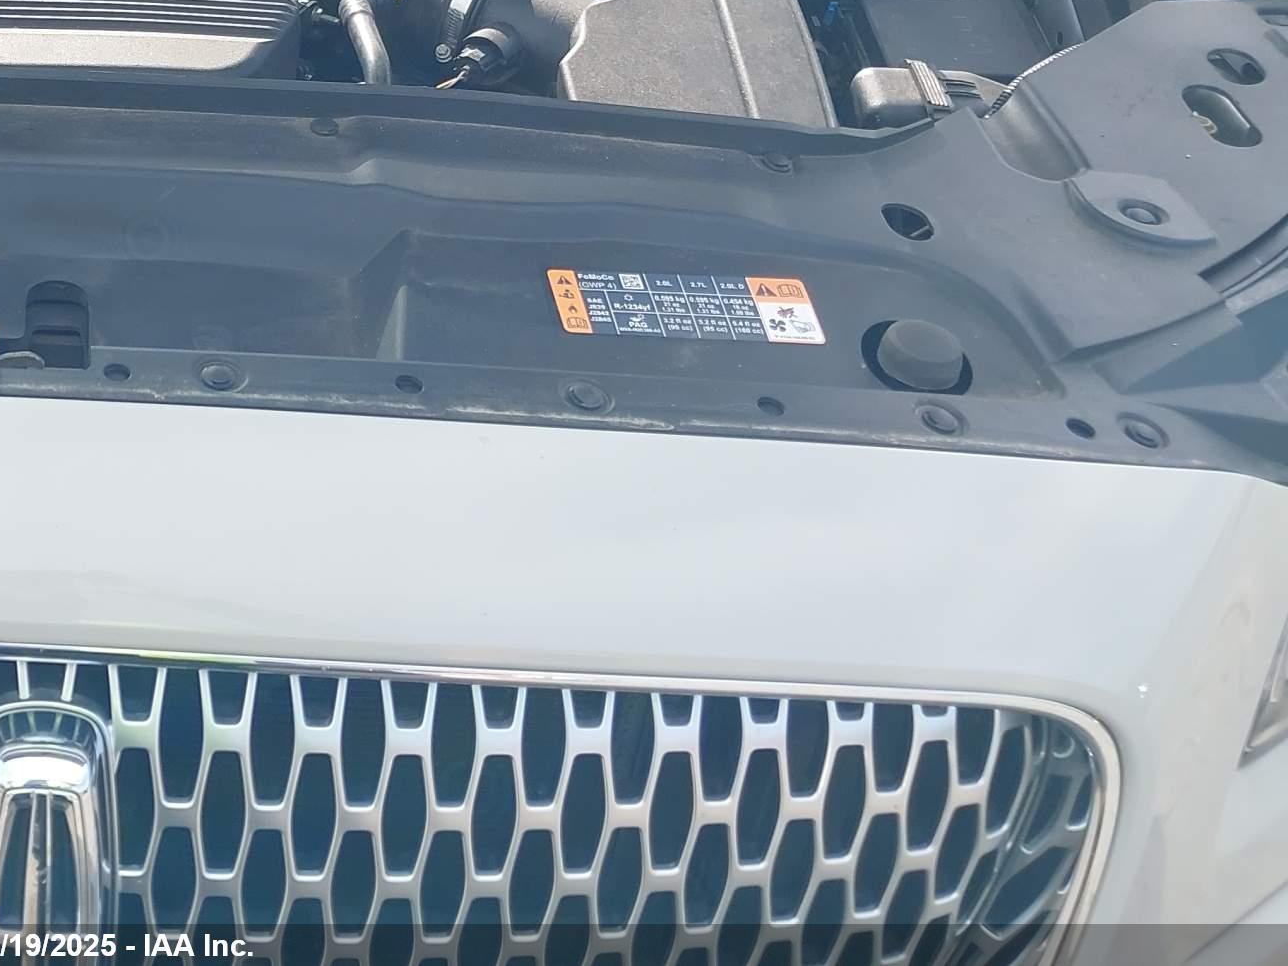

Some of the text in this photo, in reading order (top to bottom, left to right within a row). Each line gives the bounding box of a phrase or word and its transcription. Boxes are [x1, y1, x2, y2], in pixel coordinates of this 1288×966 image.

[577, 273, 615, 281] FoMoCo
[675, 295, 686, 304] kg
[709, 297, 720, 306] kg
[743, 298, 754, 307] kg
